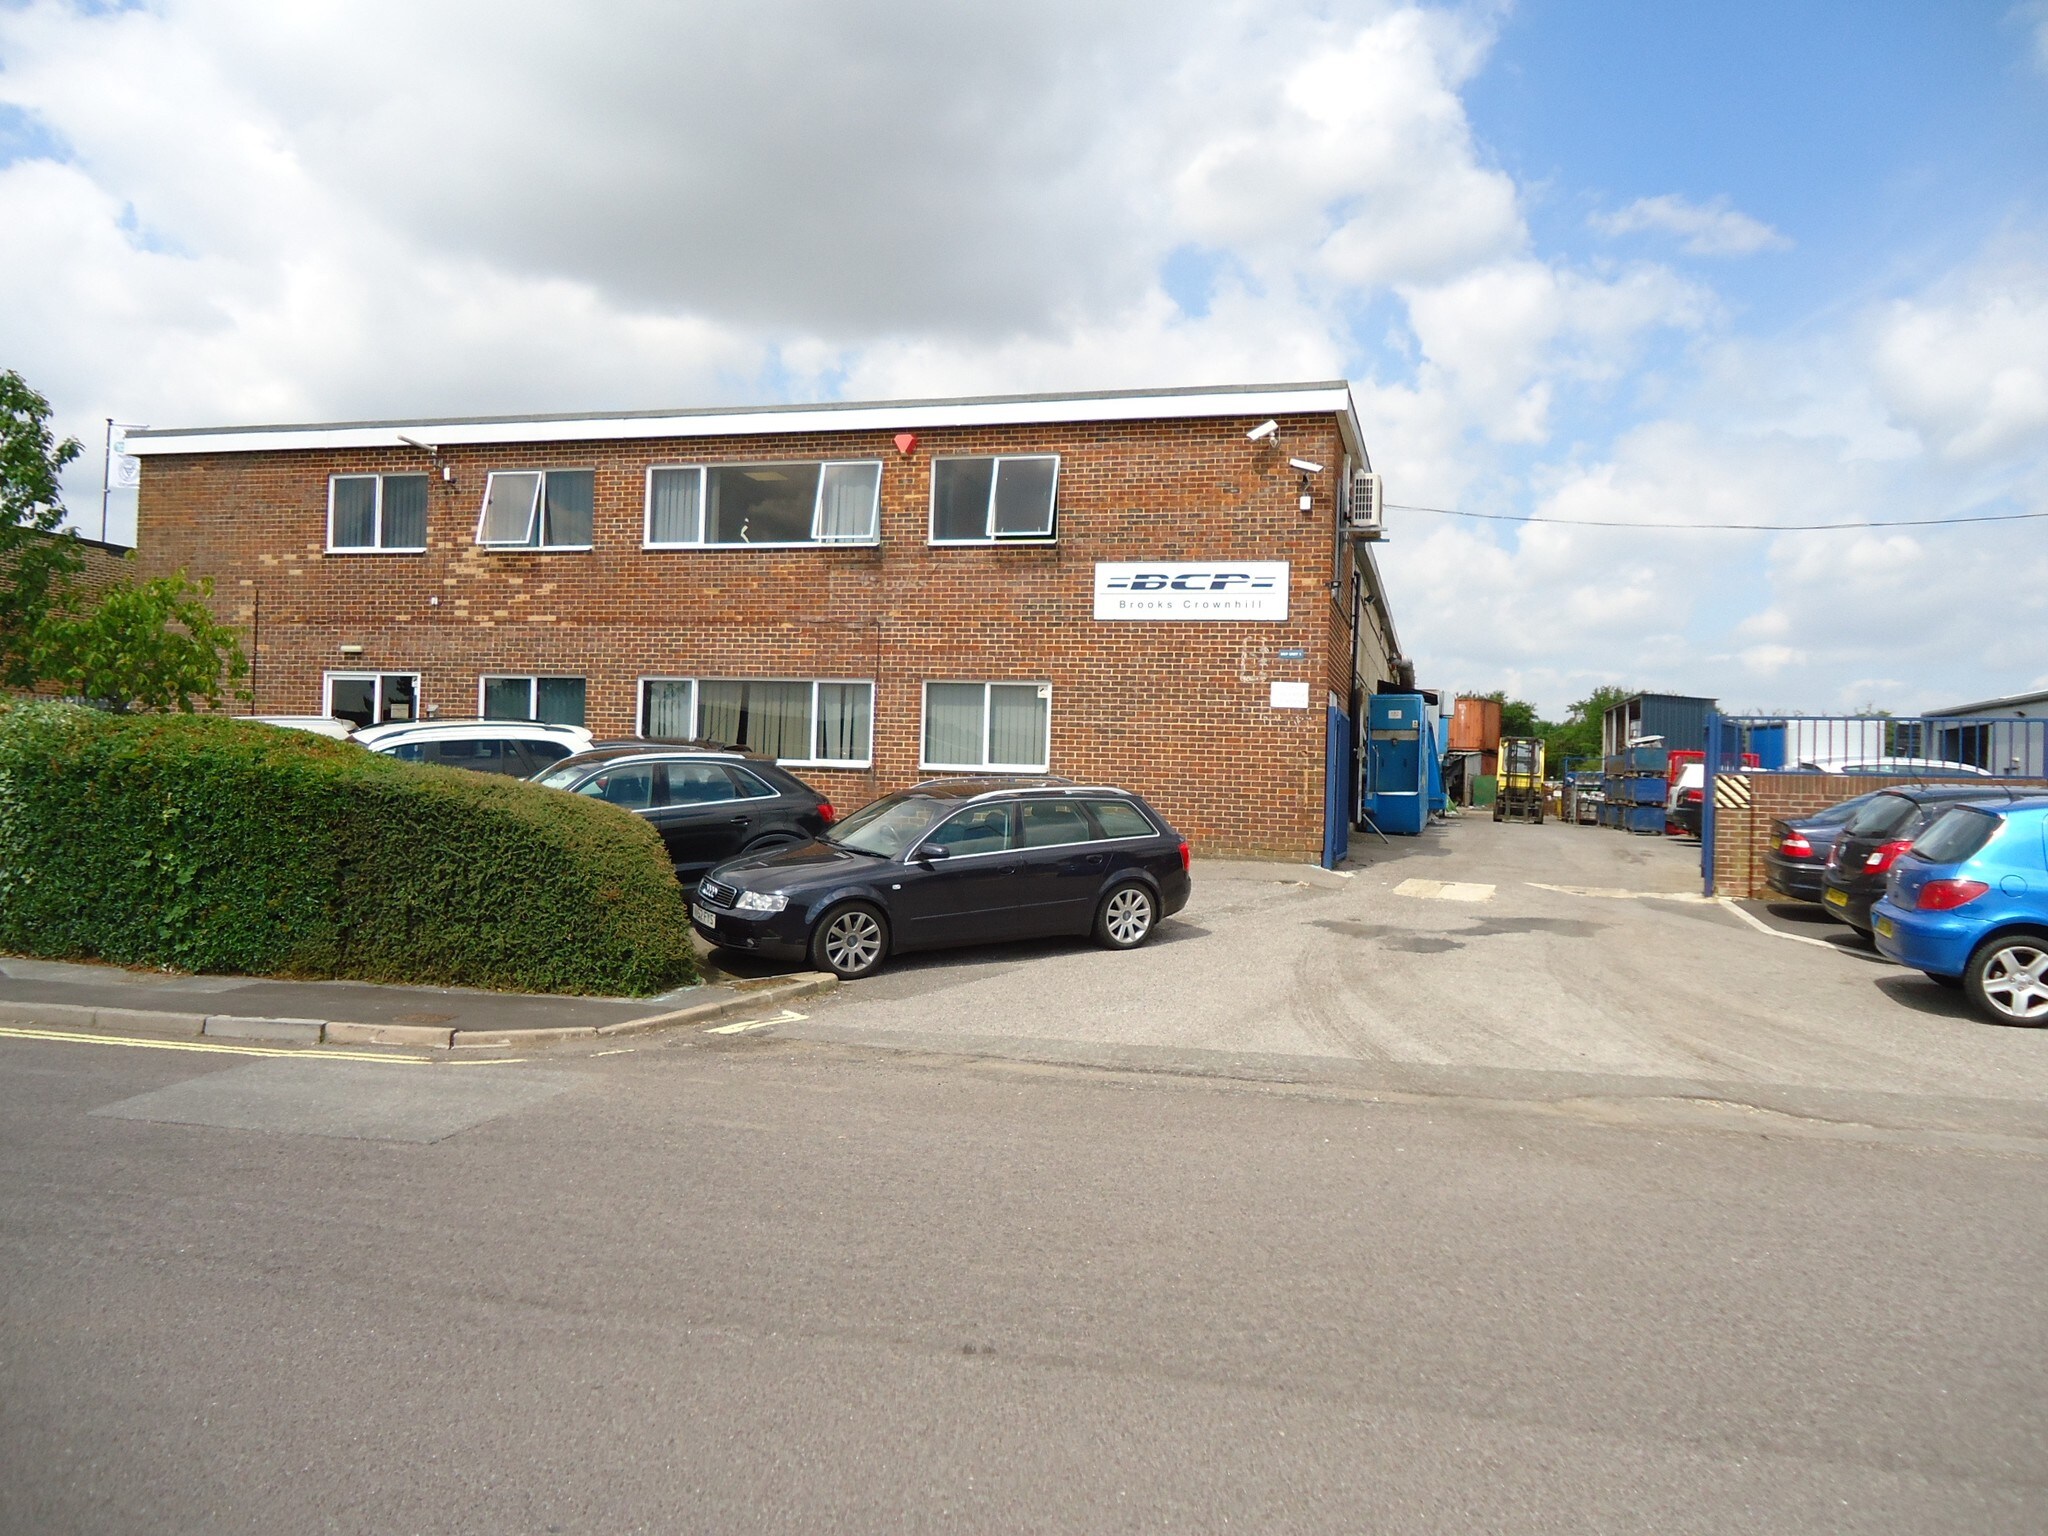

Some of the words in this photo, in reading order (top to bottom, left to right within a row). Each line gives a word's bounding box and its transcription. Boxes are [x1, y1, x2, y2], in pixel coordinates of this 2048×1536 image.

[1130, 573, 1251, 591] BCP
[1119, 600, 1173, 609] Brooks
[1183, 600, 1262, 609] Crownhill
